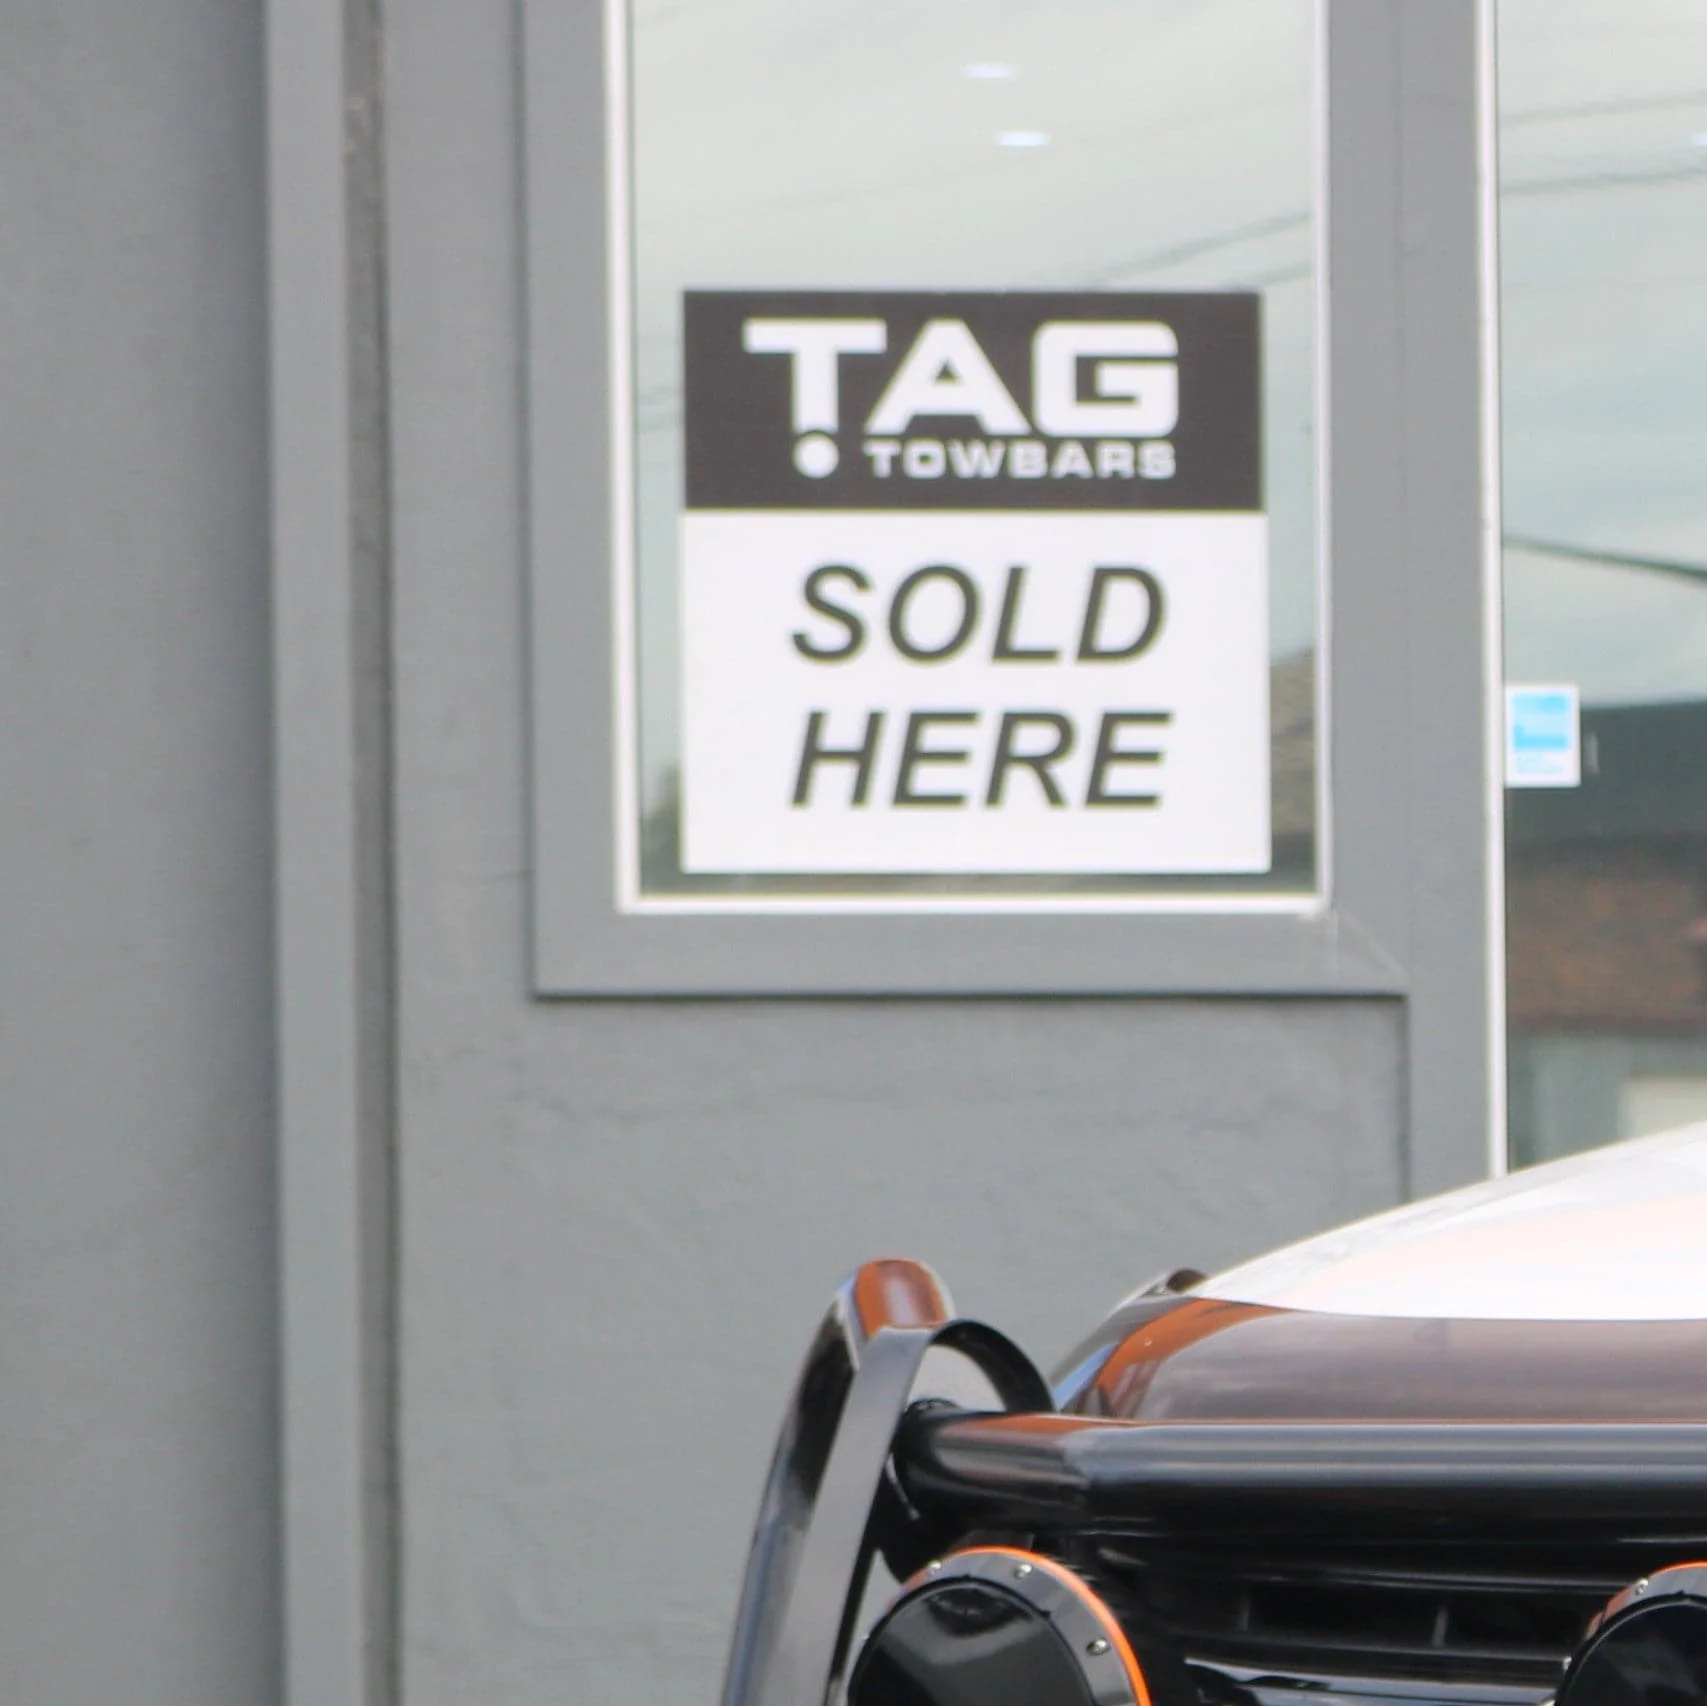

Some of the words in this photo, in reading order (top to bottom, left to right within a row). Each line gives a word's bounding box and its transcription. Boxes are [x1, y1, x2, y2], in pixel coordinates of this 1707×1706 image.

[743, 317, 1180, 438] TAG
[862, 440, 1177, 478] TOWBARS
[791, 564, 1167, 664] SOLD
[790, 710, 1173, 809] HERE
